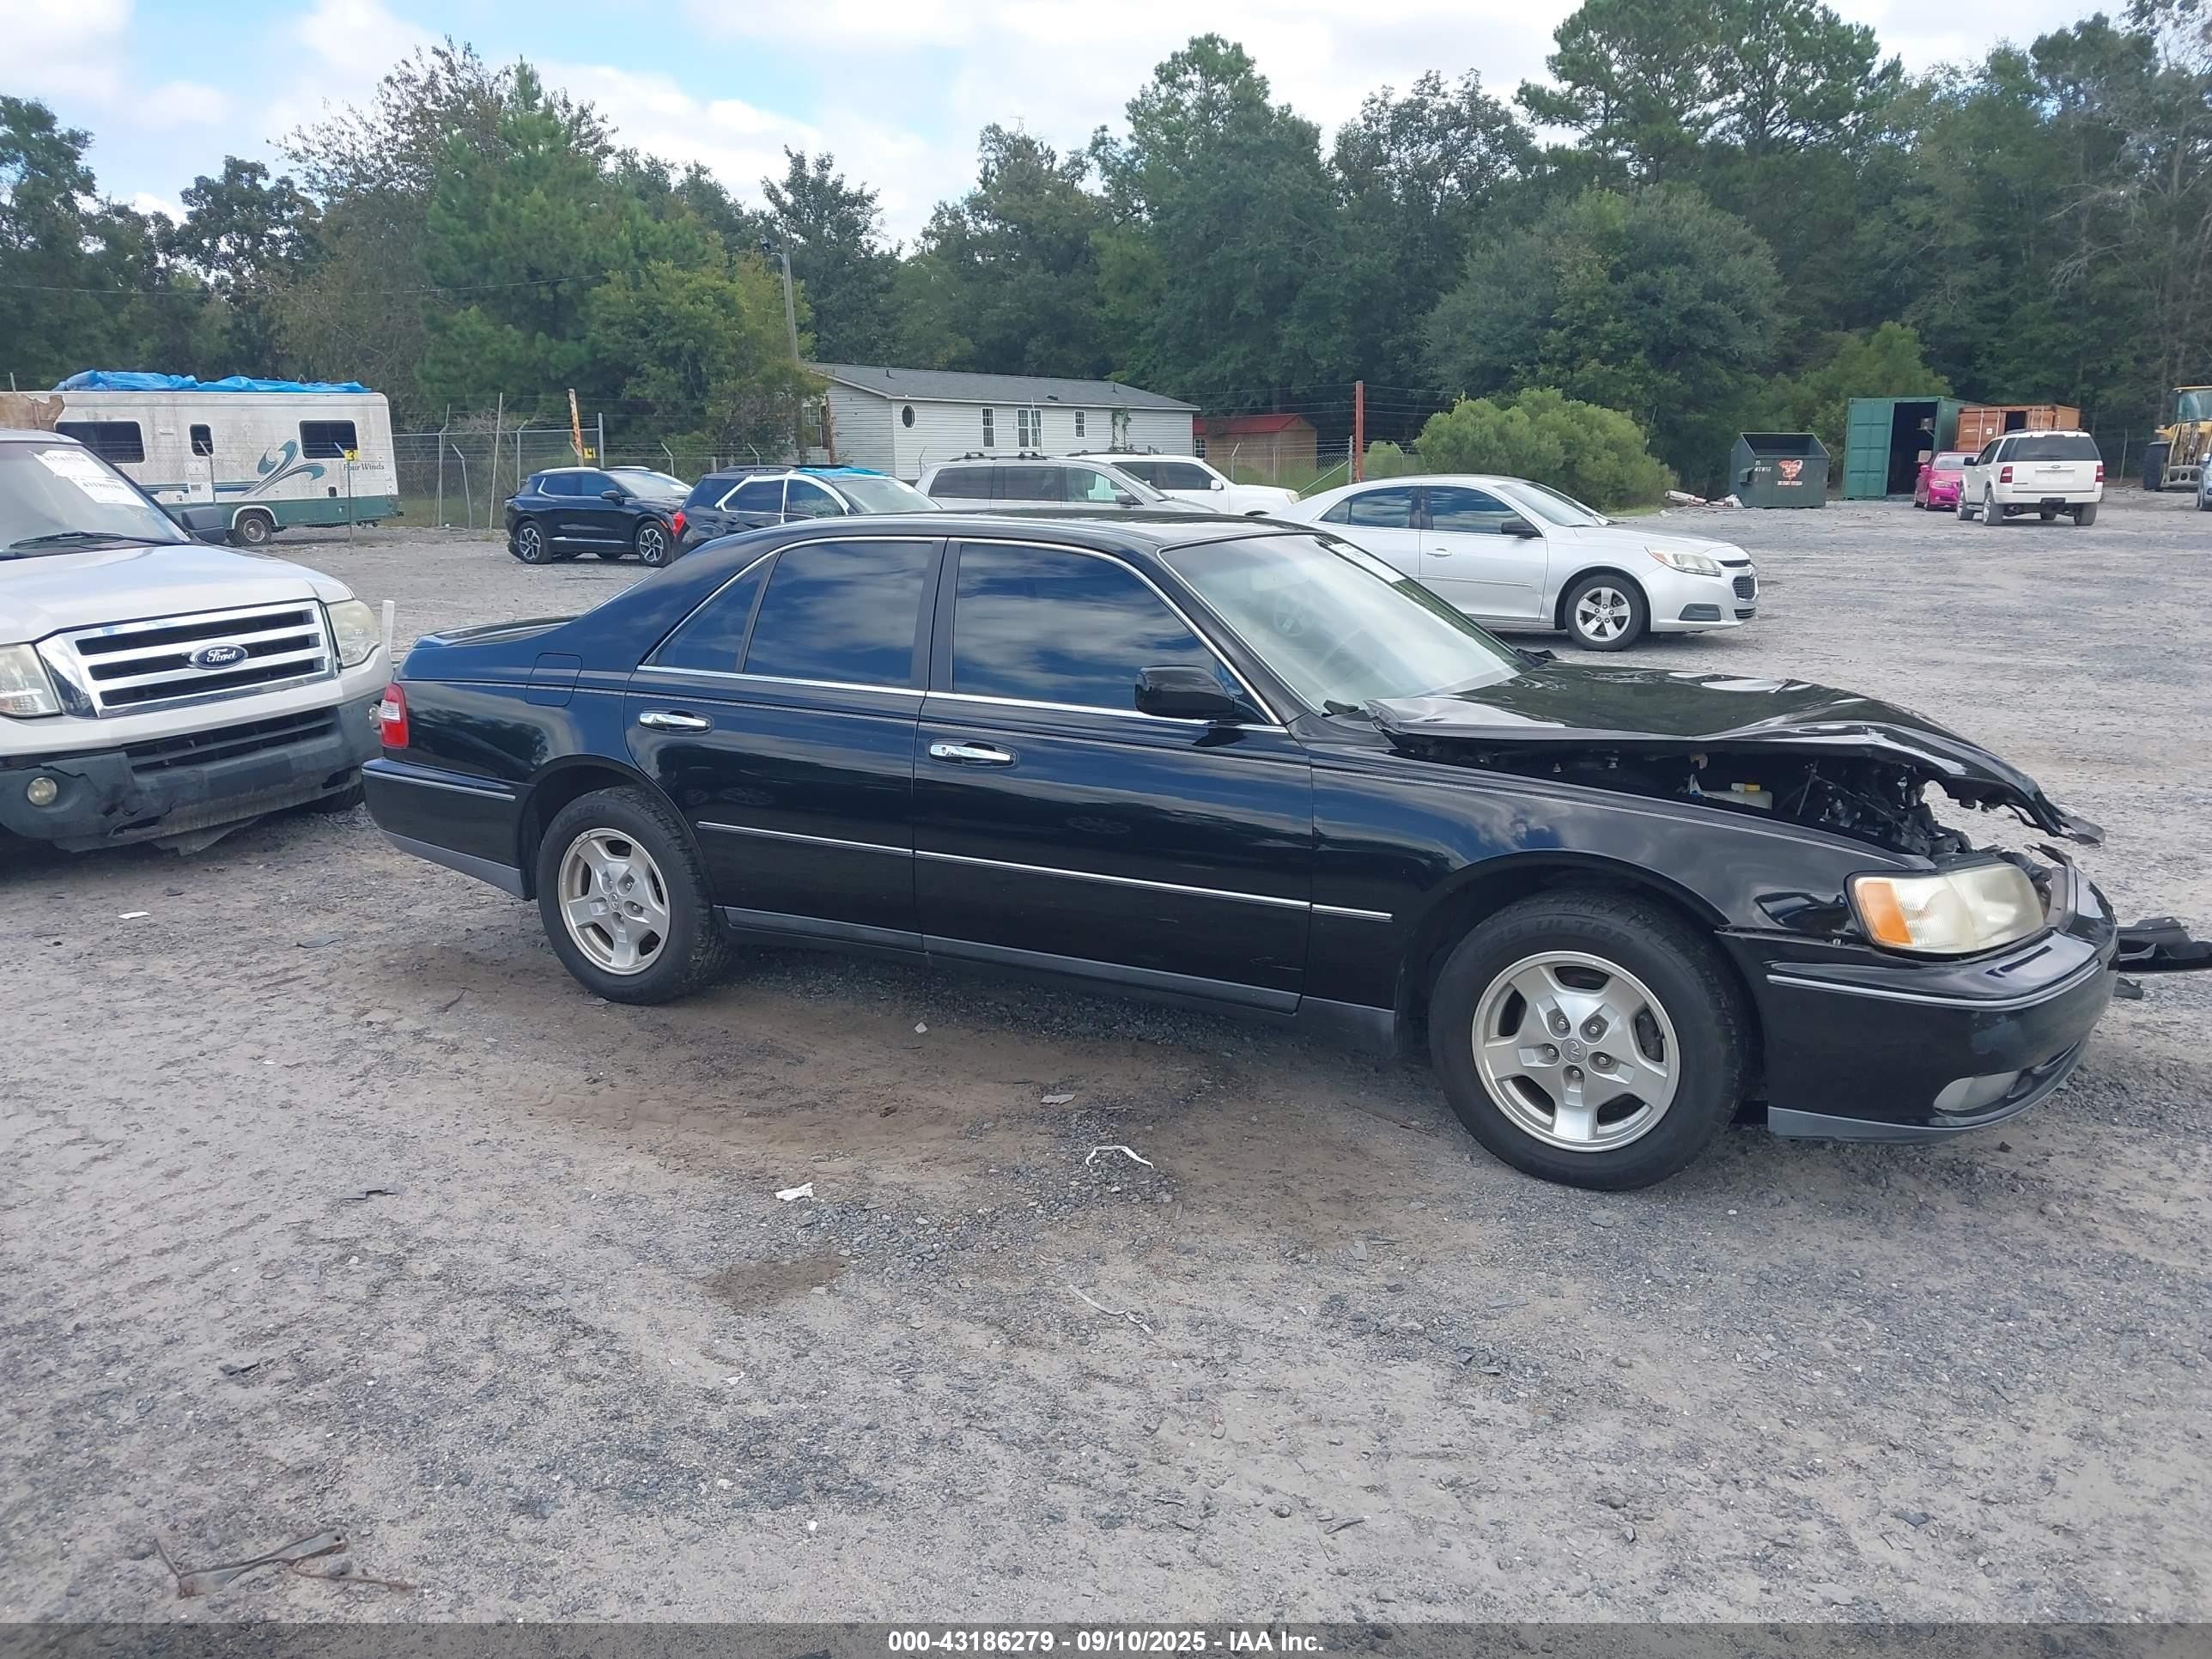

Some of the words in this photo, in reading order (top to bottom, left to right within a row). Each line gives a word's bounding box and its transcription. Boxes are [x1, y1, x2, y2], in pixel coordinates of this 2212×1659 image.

[362, 462, 386, 471] Winds
[206, 647, 237, 663] Ford
[1536, 918, 1634, 944] ULTRA
